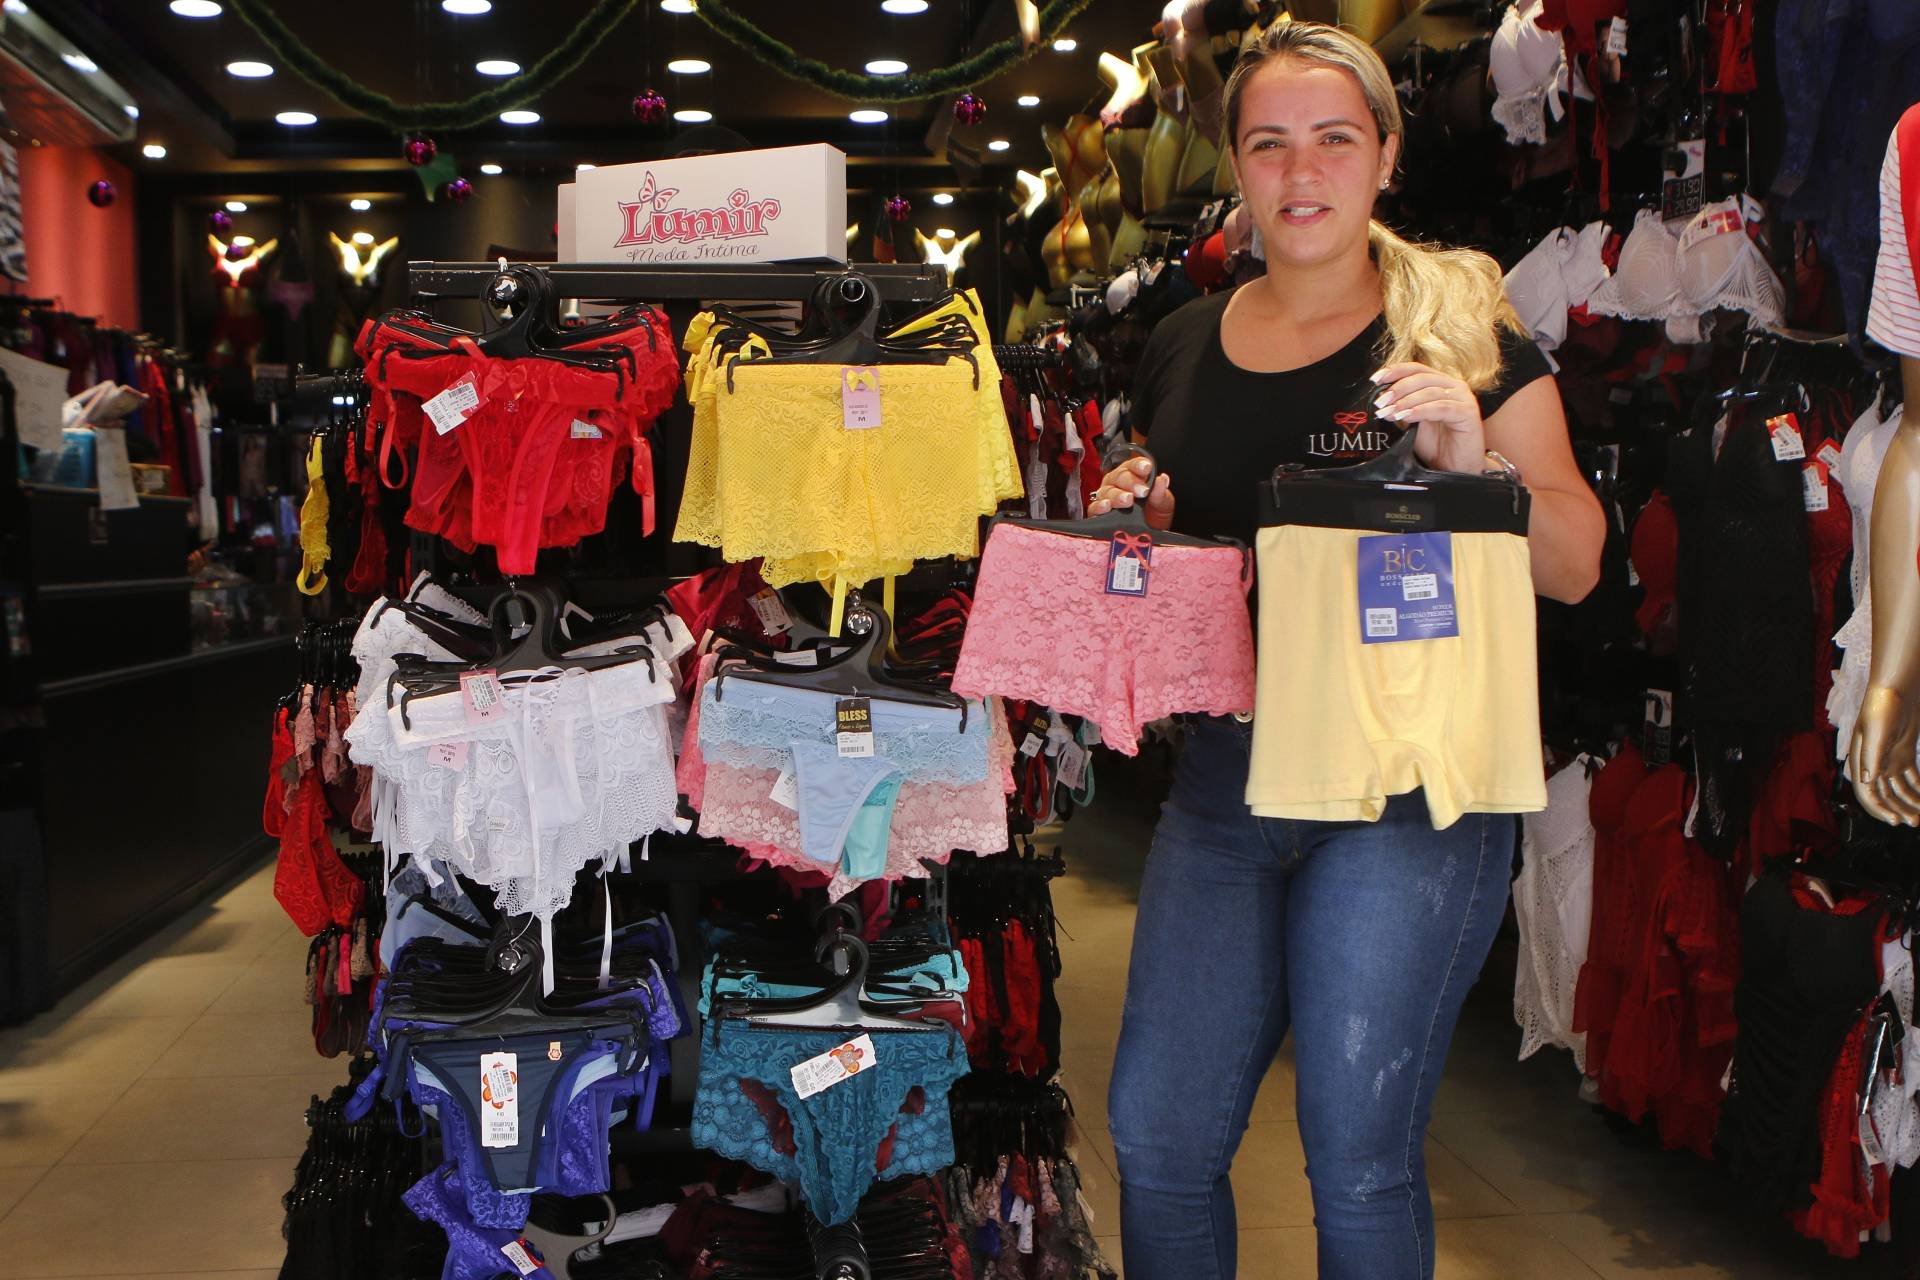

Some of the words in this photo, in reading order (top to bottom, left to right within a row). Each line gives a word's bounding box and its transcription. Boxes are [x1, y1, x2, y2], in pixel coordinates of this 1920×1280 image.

[613, 188, 781, 248] Lumir
[626, 247, 689, 263] Moda
[1307, 431, 1390, 456] LUMIR
[838, 709, 867, 722] BLESS
